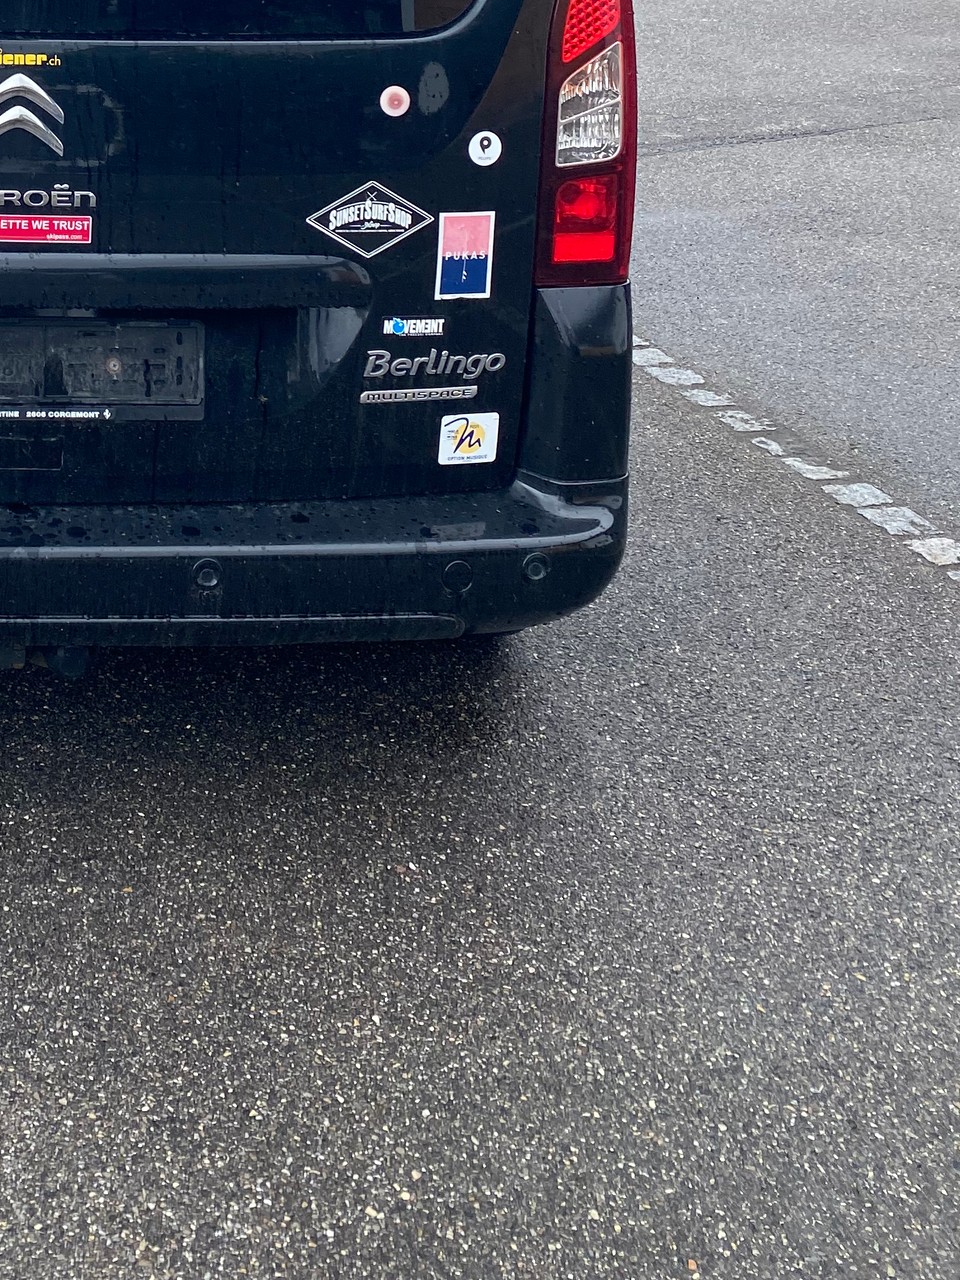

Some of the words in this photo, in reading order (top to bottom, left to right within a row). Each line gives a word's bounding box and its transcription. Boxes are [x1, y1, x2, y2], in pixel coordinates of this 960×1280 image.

[31, 220, 49, 230] WE
[53, 221, 89, 231] TRUST
[445, 250, 486, 261] PUKAS
[363, 348, 506, 380] Berlingo
[366, 388, 473, 402] MULTISPACE
[47, 411, 100, 419] CORGEMONT
